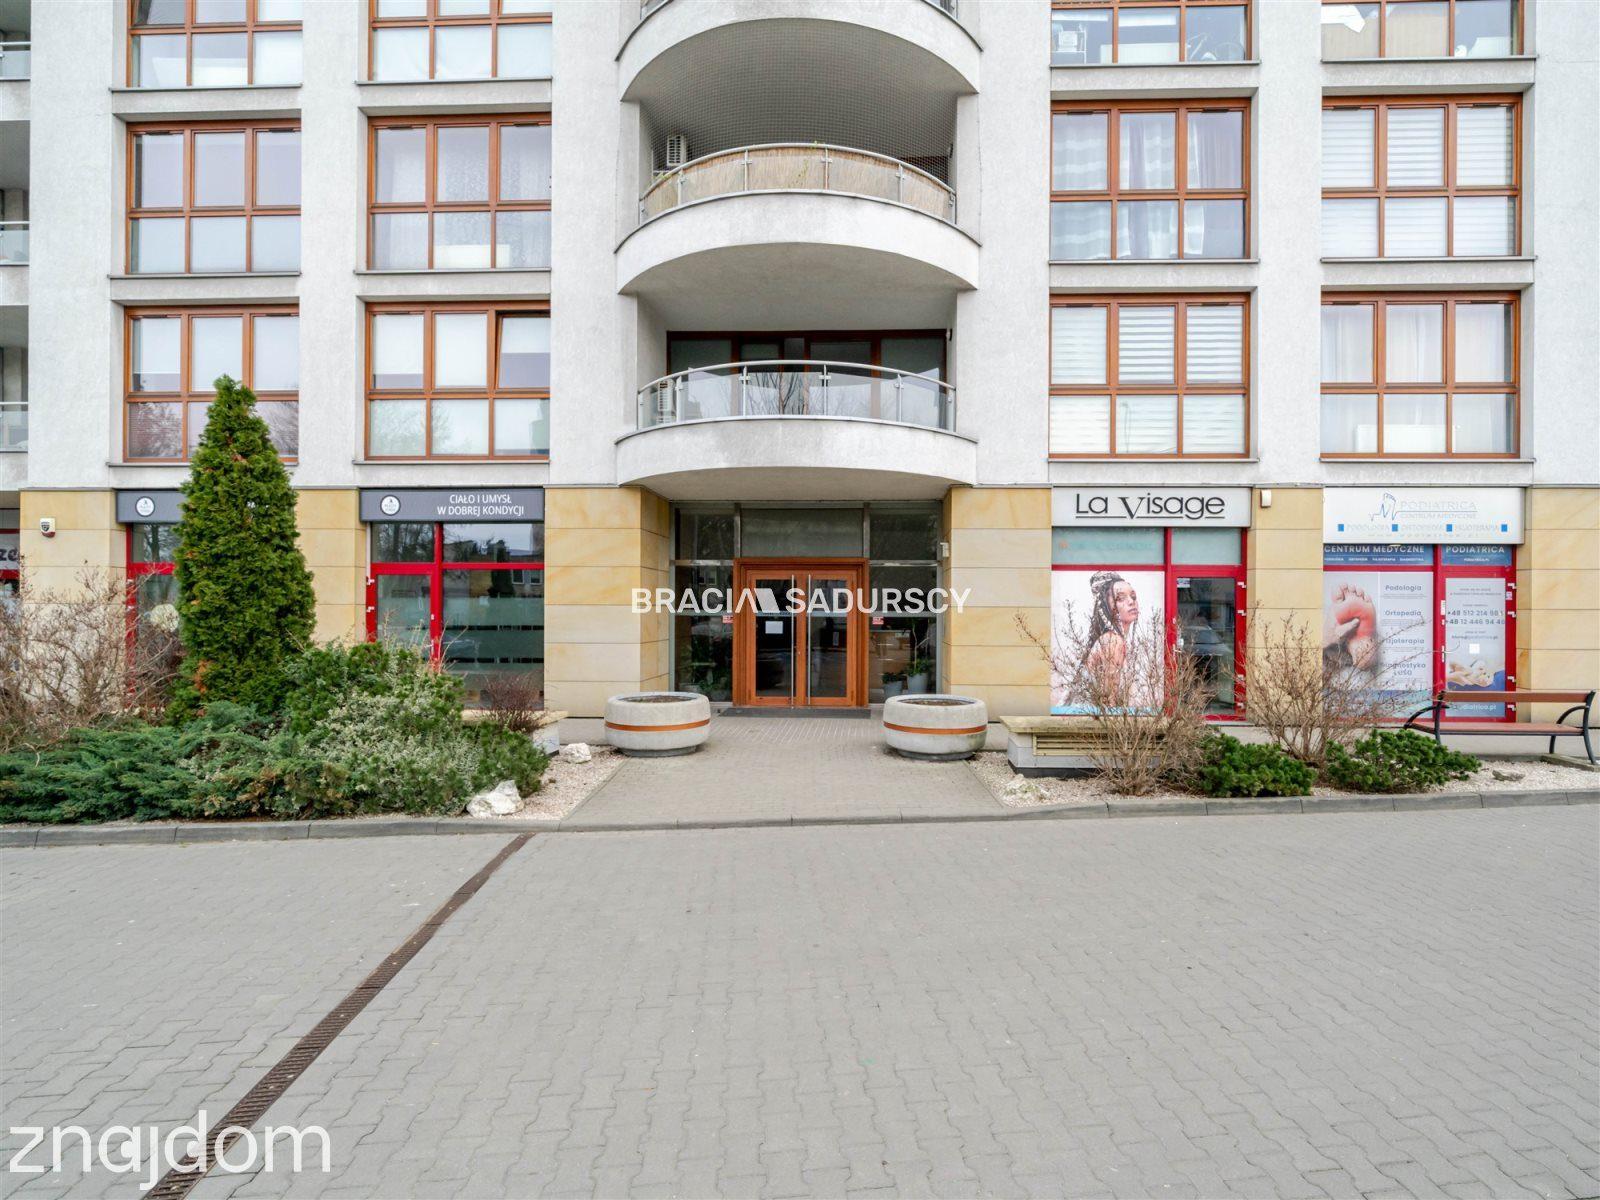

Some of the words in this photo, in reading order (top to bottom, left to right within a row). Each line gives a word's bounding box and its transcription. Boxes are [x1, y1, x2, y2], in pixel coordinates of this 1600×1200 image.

[449, 494, 476, 504] CIAŁO
[477, 494, 481, 504] I
[482, 494, 512, 504] UMYSŁ
[1076, 493, 1108, 514] La
[1118, 492, 1226, 520] Visage
[1400, 501, 1477, 510] PODIATRICA
[437, 506, 447, 515] W
[448, 506, 481, 516] DOBREJ
[482, 506, 524, 516] KONDYCJI
[1324, 545, 1370, 553] CENTRUM
[1372, 545, 1425, 553] MEDYCZNE
